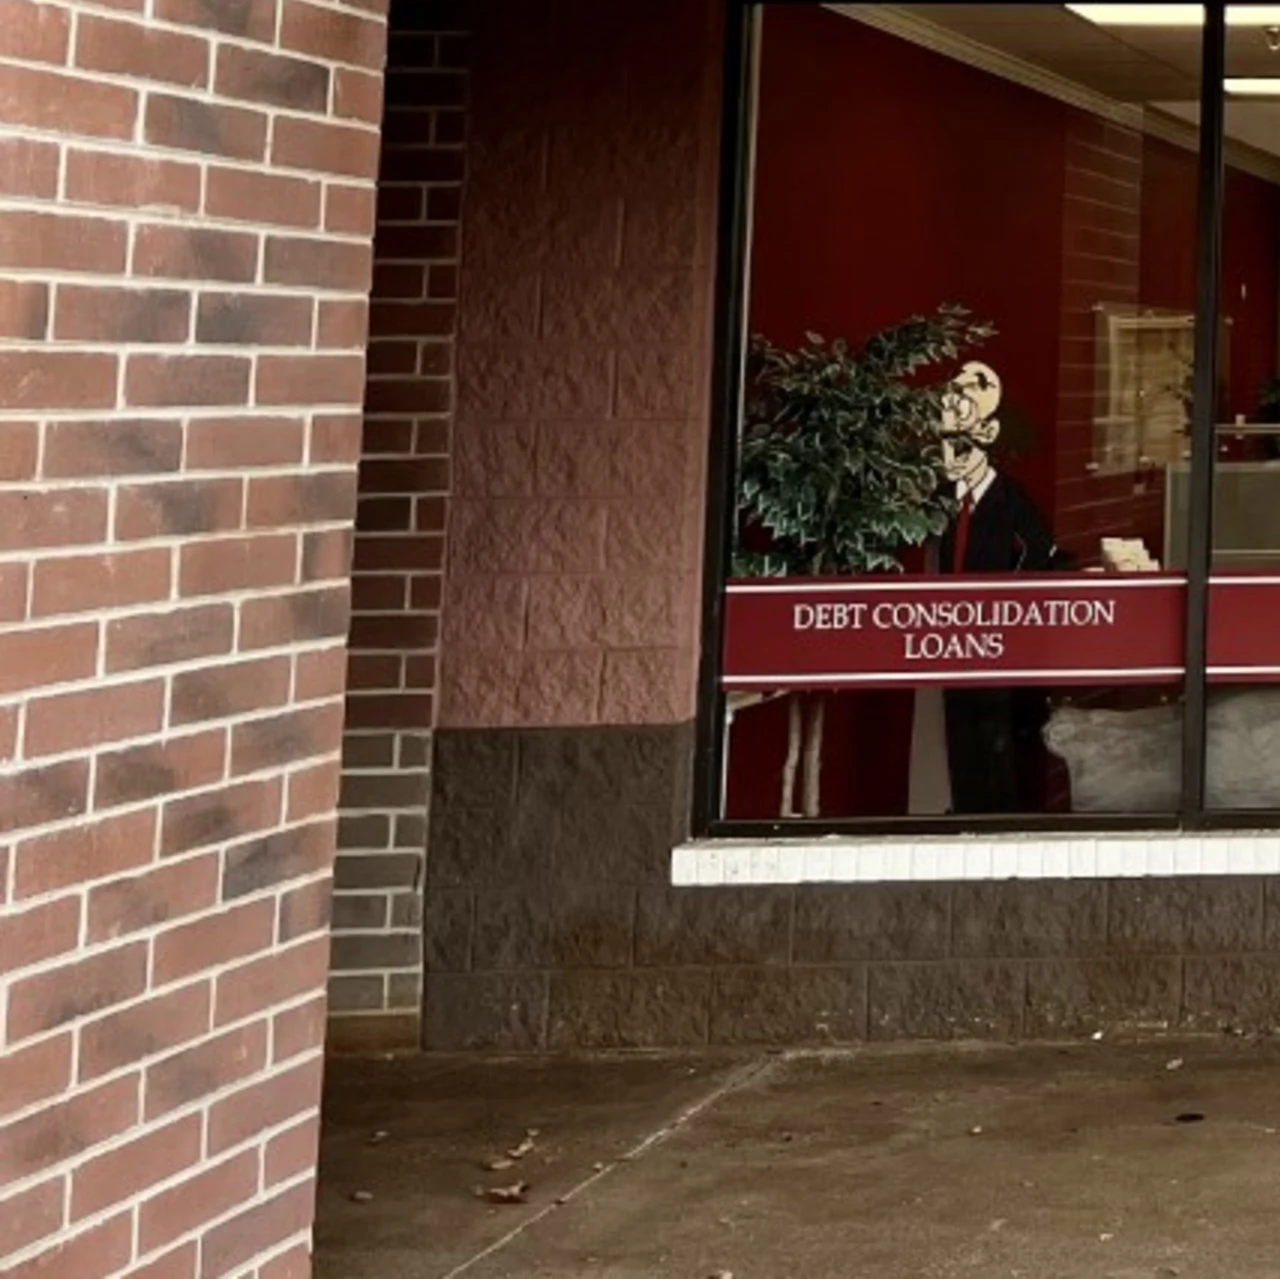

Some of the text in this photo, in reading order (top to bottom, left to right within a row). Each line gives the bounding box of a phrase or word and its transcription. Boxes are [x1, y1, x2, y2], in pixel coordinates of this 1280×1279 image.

[793, 599, 1116, 630] DEBT CONSOLIDATION
[904, 633, 1005, 660] LOANS
